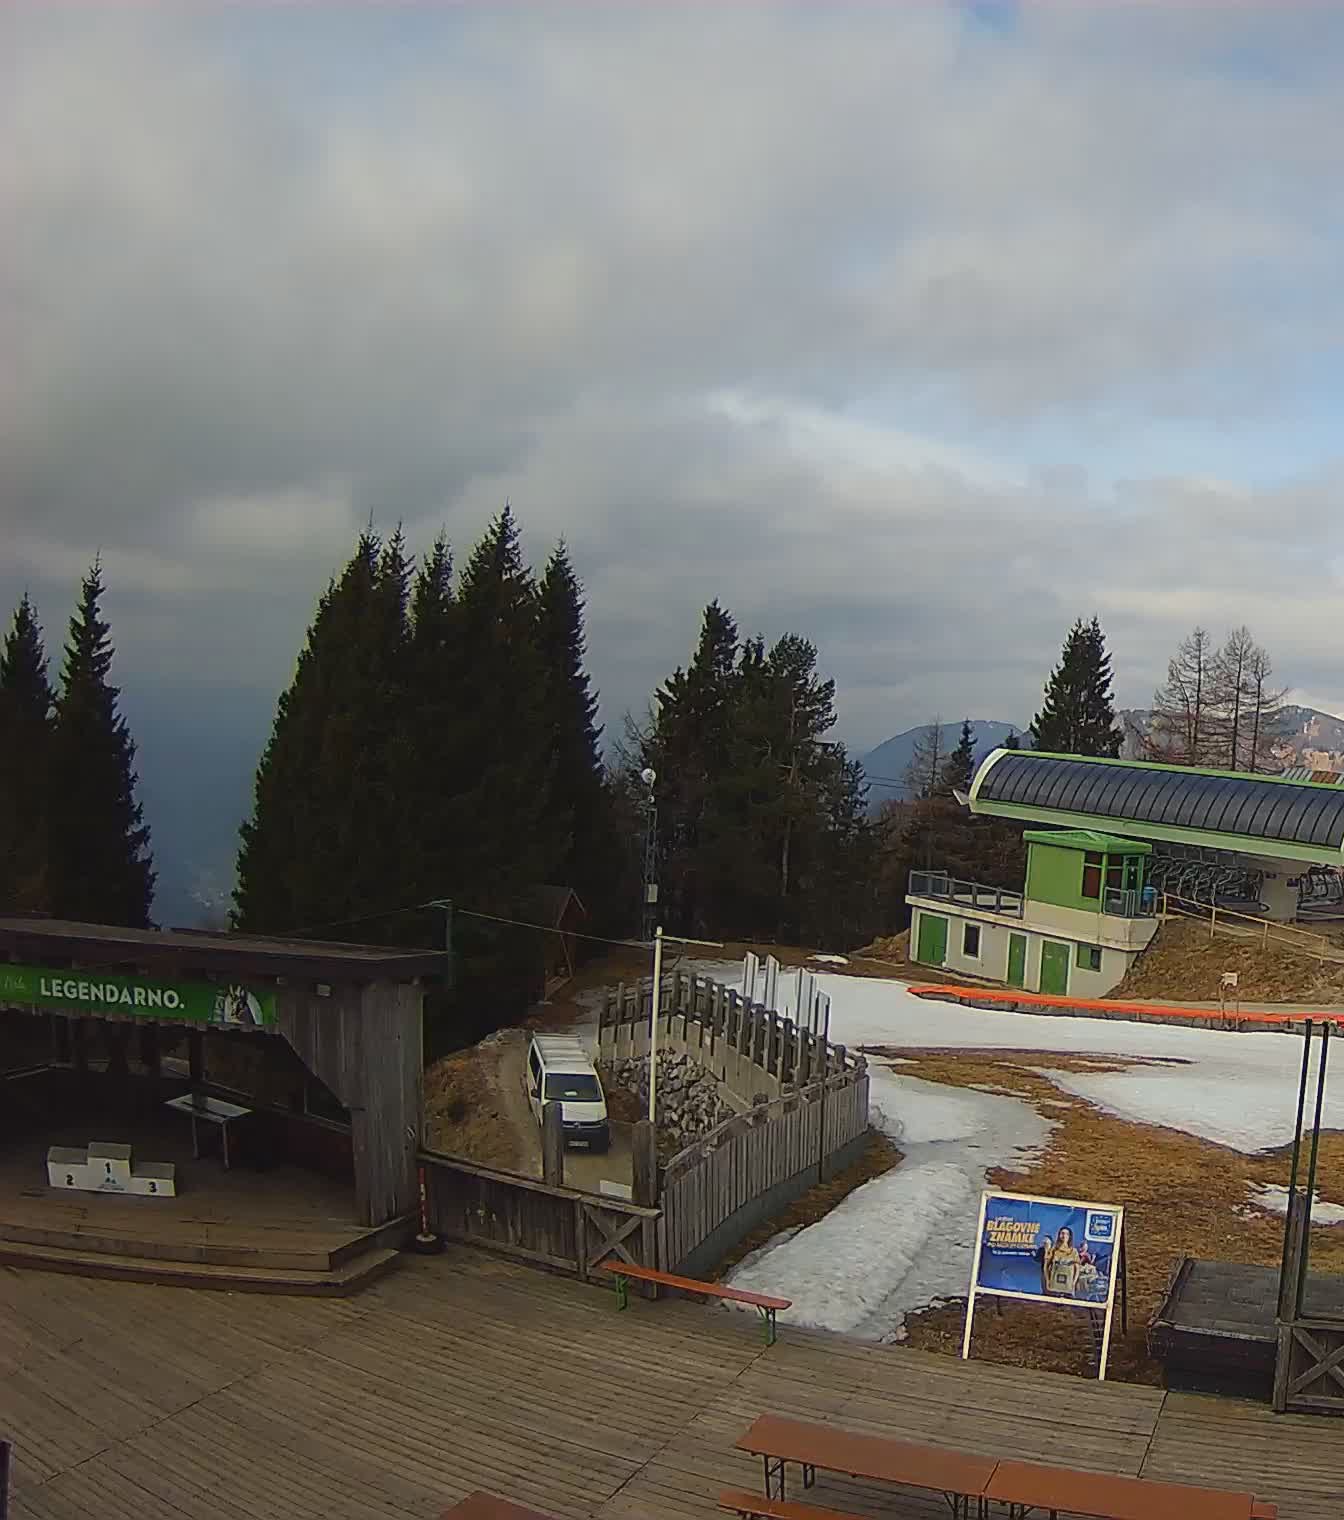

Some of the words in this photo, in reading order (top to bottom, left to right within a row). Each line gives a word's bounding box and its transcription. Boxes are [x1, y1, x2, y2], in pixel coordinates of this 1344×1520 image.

[40, 977, 185, 1009] LEGENDARNO.
[105, 1162, 111, 1174] 1
[66, 1174, 74, 1186] 2
[148, 1181, 157, 1193] 3
